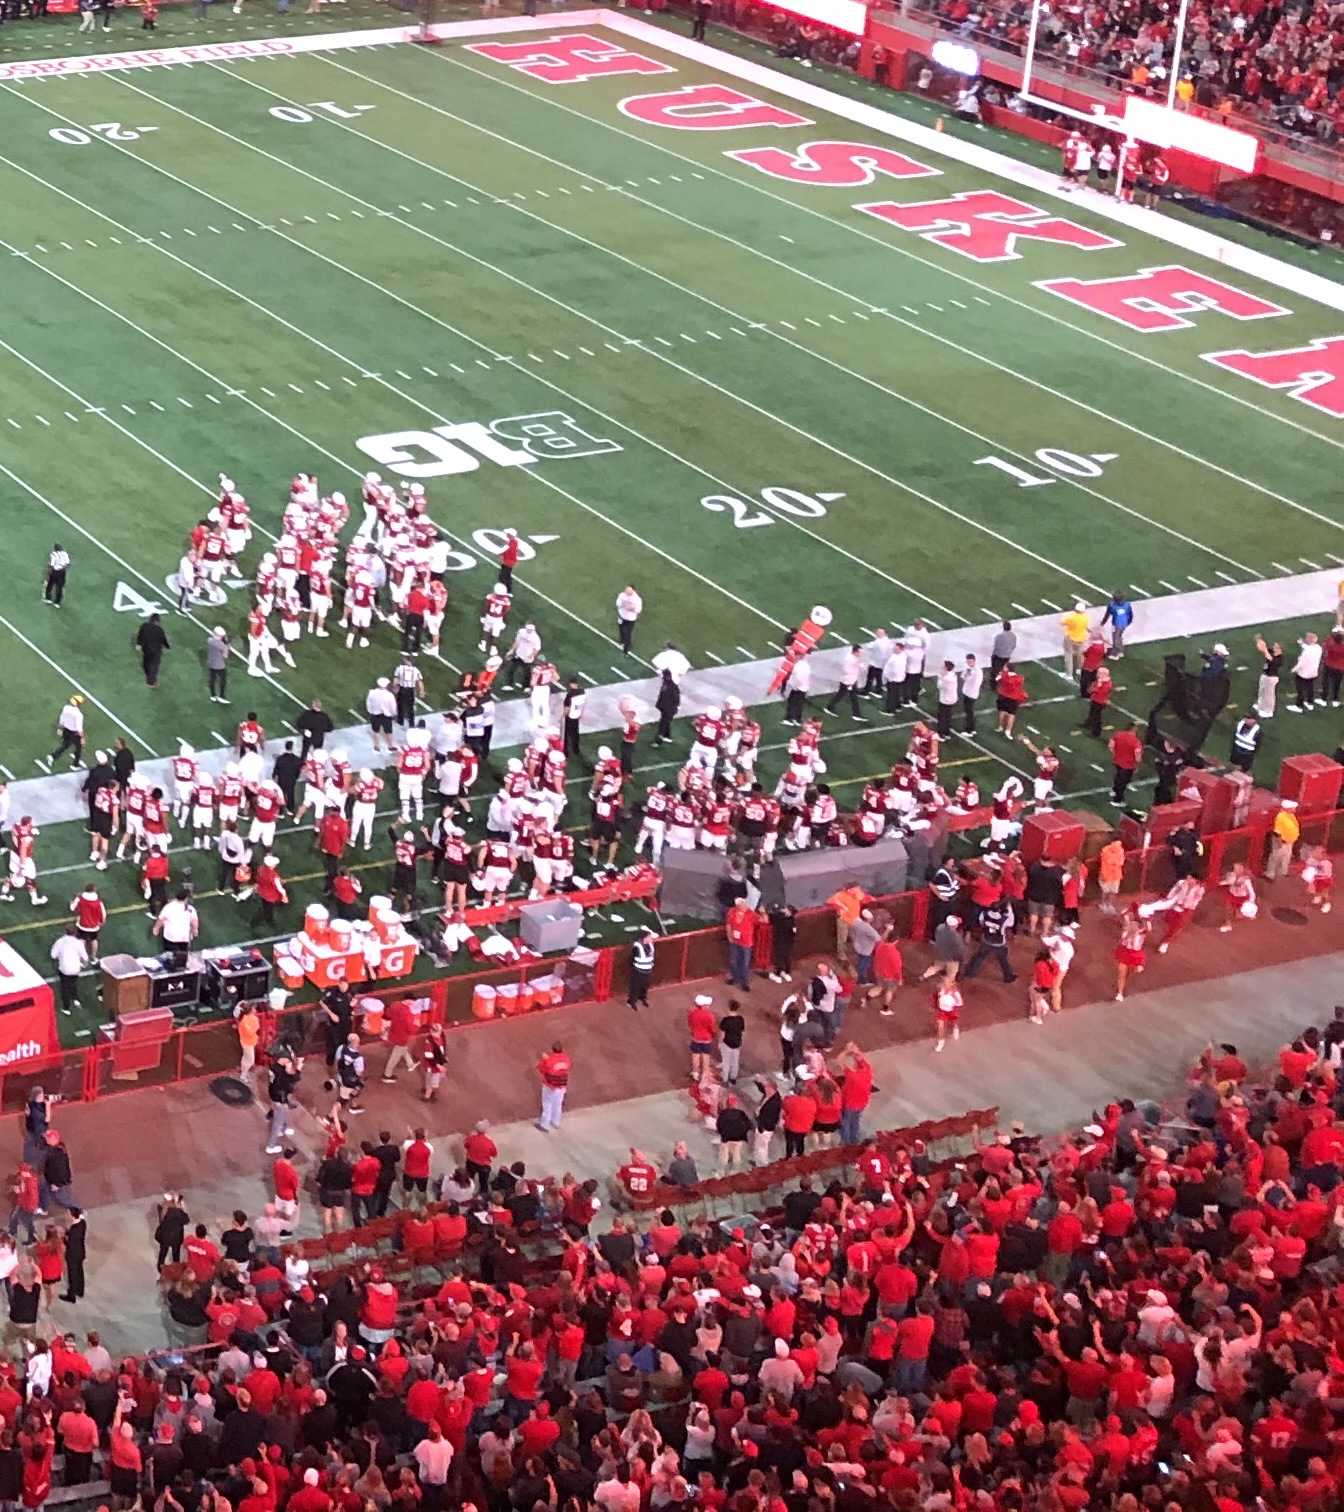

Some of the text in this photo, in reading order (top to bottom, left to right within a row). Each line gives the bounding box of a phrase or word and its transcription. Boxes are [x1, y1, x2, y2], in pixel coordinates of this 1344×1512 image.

[175, 39, 295, 63] FIELD
[269, 101, 360, 124] 10
[48, 122, 141, 146] 20
[973, 447, 1104, 489] 10
[700, 486, 830, 530] 20
[326, 958, 347, 981] G
[385, 950, 405, 972] G
[871, 1159, 881, 1173] 7
[630, 1177, 647, 1191] 22
